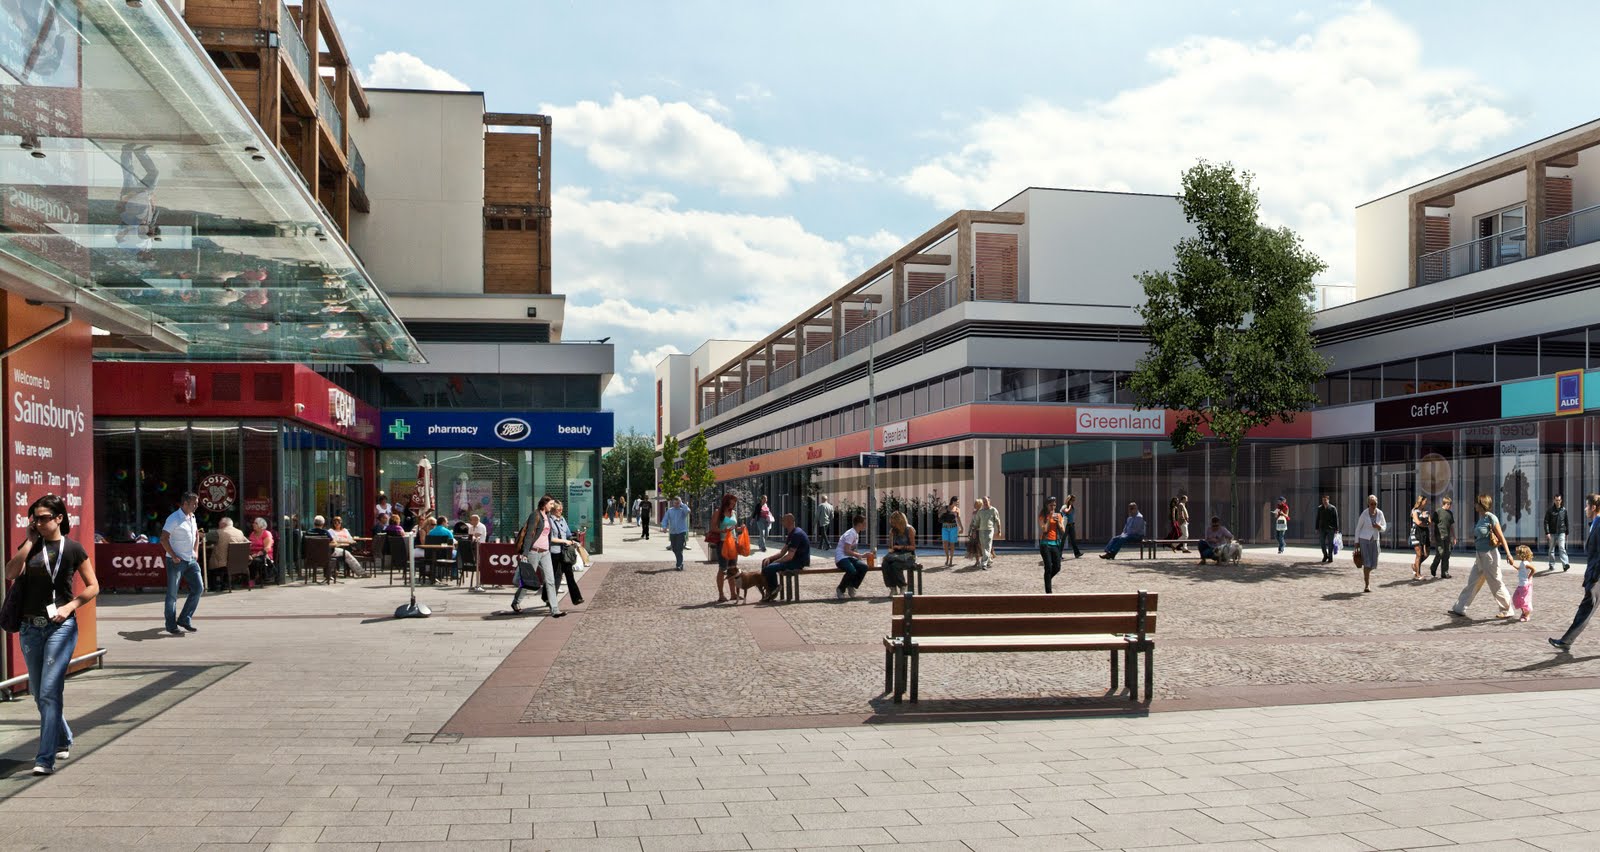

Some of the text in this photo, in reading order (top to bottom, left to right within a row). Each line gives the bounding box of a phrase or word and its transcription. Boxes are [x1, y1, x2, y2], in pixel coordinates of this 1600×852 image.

[13, 368, 51, 390] Welcome to
[14, 391, 85, 437] Sainsbury's
[1411, 400, 1449, 418] CafeFX
[1079, 412, 1161, 430] Greenland
[428, 423, 592, 436] pharmacy Boots beauty
[883, 425, 907, 444] Greenland
[15, 441, 53, 460] We are open
[1501, 444, 1518, 456] Quality
[47, 471, 61, 486] 7am
[203, 476, 230, 487] COSTA
[15, 491, 28, 506] Sat
[66, 493, 82, 509] 10pm
[202, 497, 233, 510] COFFEE
[15, 513, 30, 528] Sun
[112, 556, 165, 570] COSTA
[489, 554, 520, 568] COS
